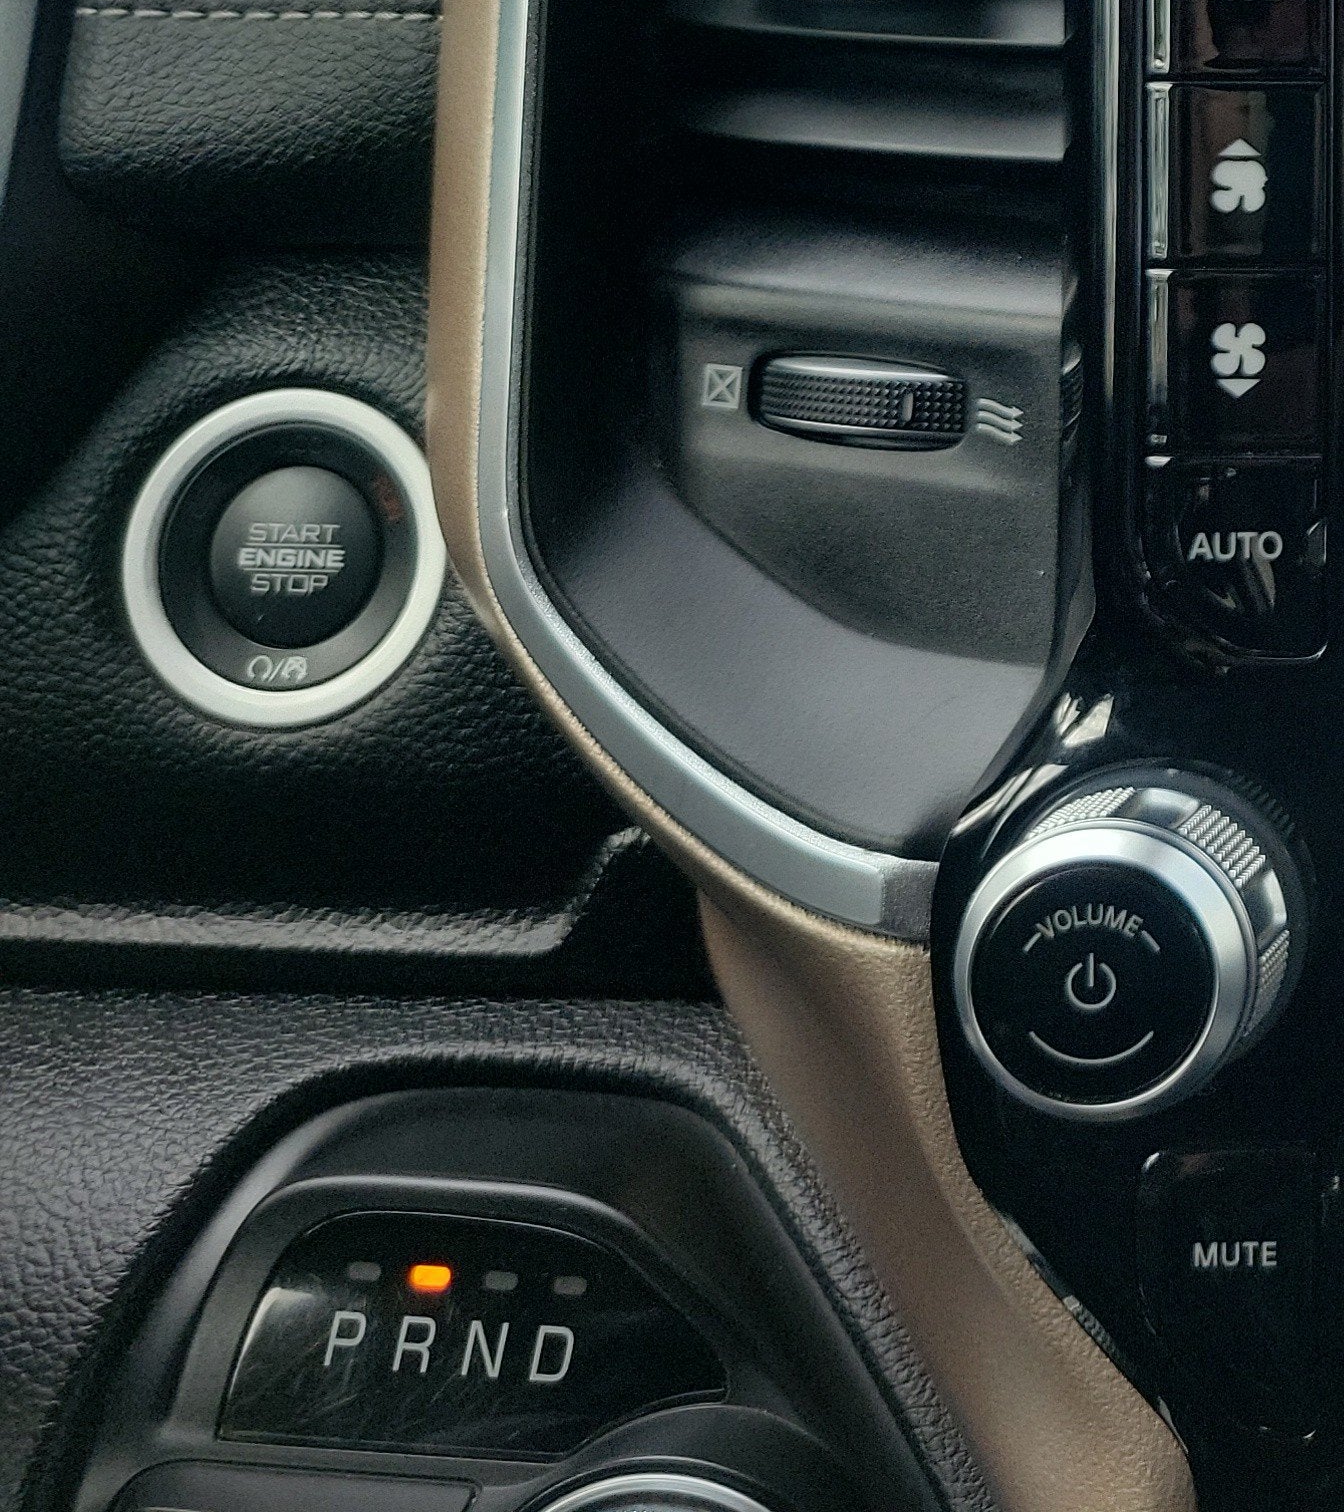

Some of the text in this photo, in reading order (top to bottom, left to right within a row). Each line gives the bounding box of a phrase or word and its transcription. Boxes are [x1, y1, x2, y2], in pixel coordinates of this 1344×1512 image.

[249, 522, 341, 544] START
[239, 548, 346, 569] ENGINE
[1188, 531, 1283, 564] AUTO
[251, 573, 329, 595] STOP
[1036, 903, 1143, 939] VOLUME
[1193, 1240, 1278, 1268] MUTE
